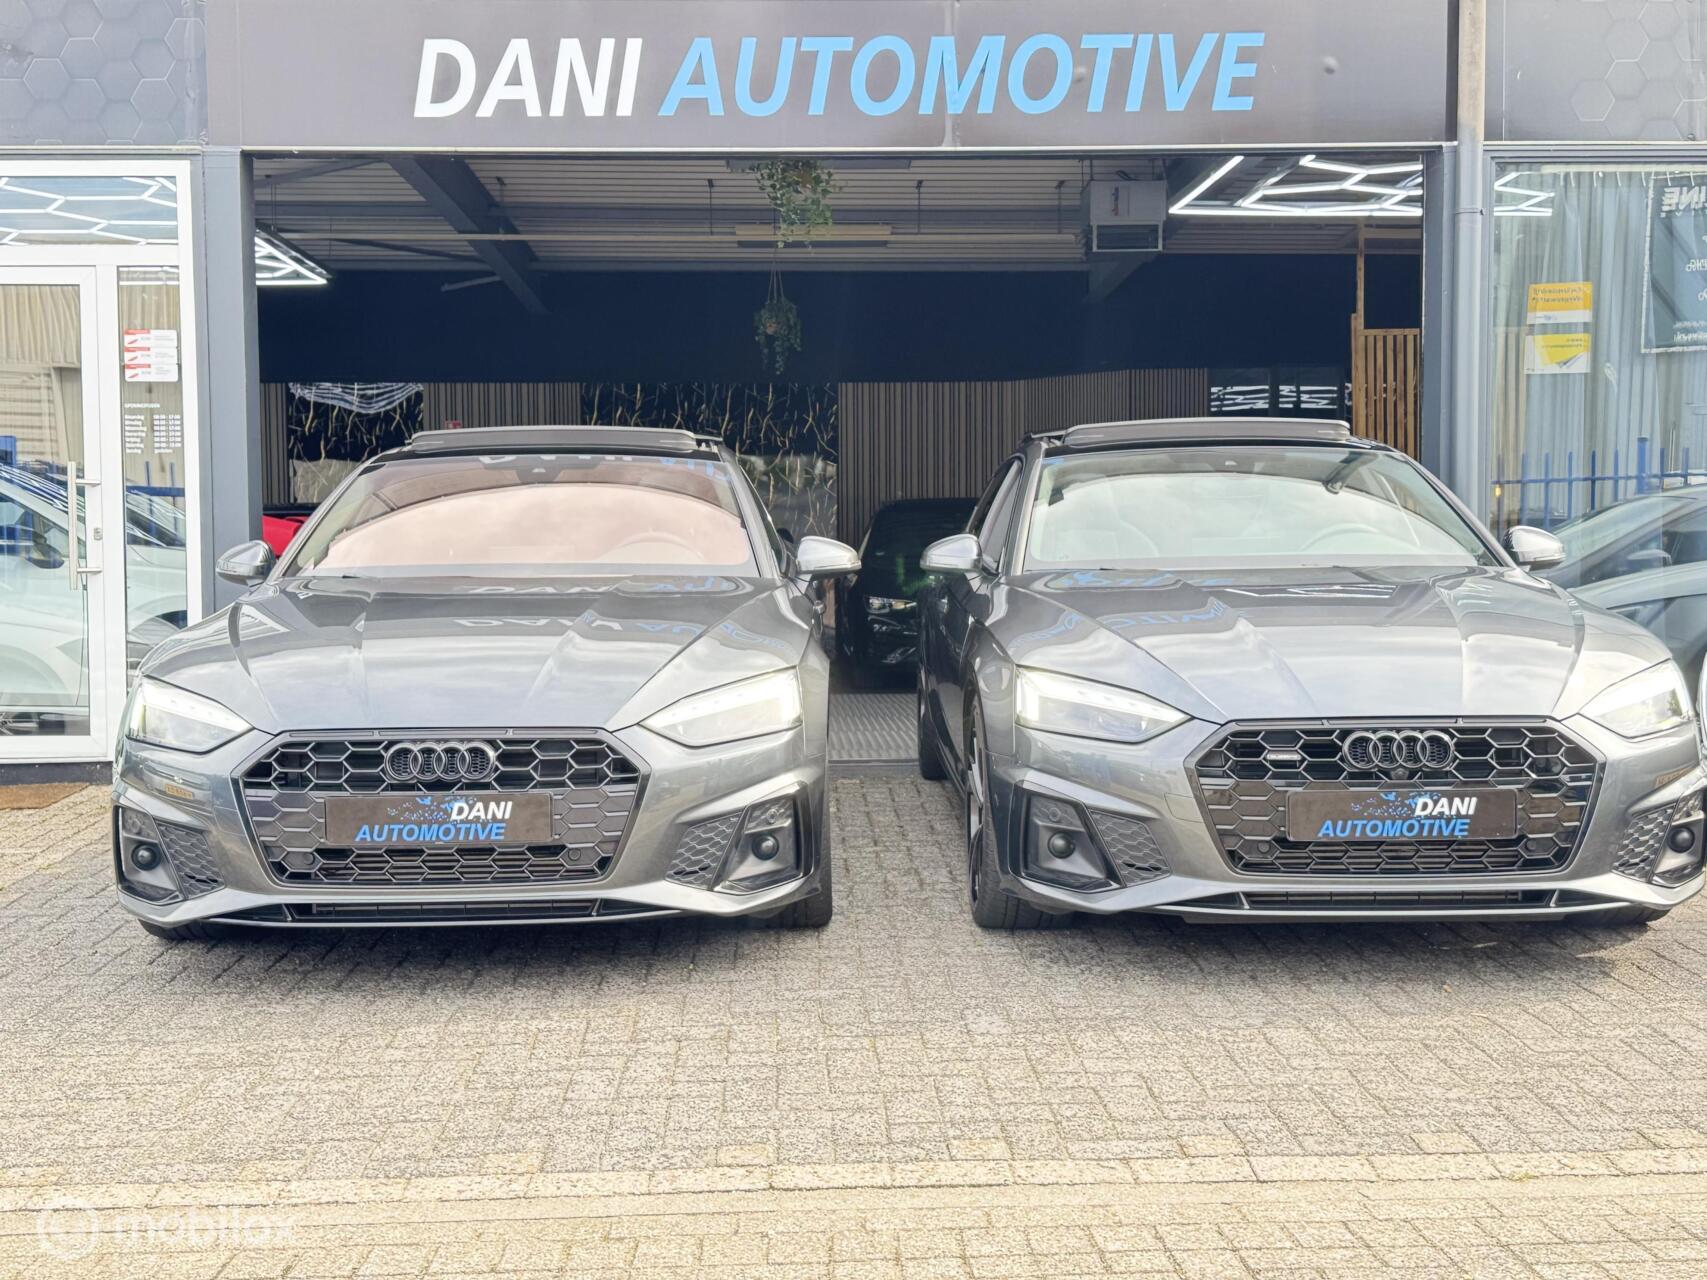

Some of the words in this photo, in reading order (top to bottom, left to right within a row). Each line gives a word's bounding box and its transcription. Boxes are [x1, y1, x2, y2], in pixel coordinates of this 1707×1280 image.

[413, 37, 643, 118] DANI
[657, 32, 1265, 116] AUTOMOTIVE
[450, 801, 513, 821] DANI
[1414, 797, 1478, 816] DANI
[354, 822, 507, 842] AUTOMOTIVE
[1318, 818, 1471, 838] AUTOMOTIVE
